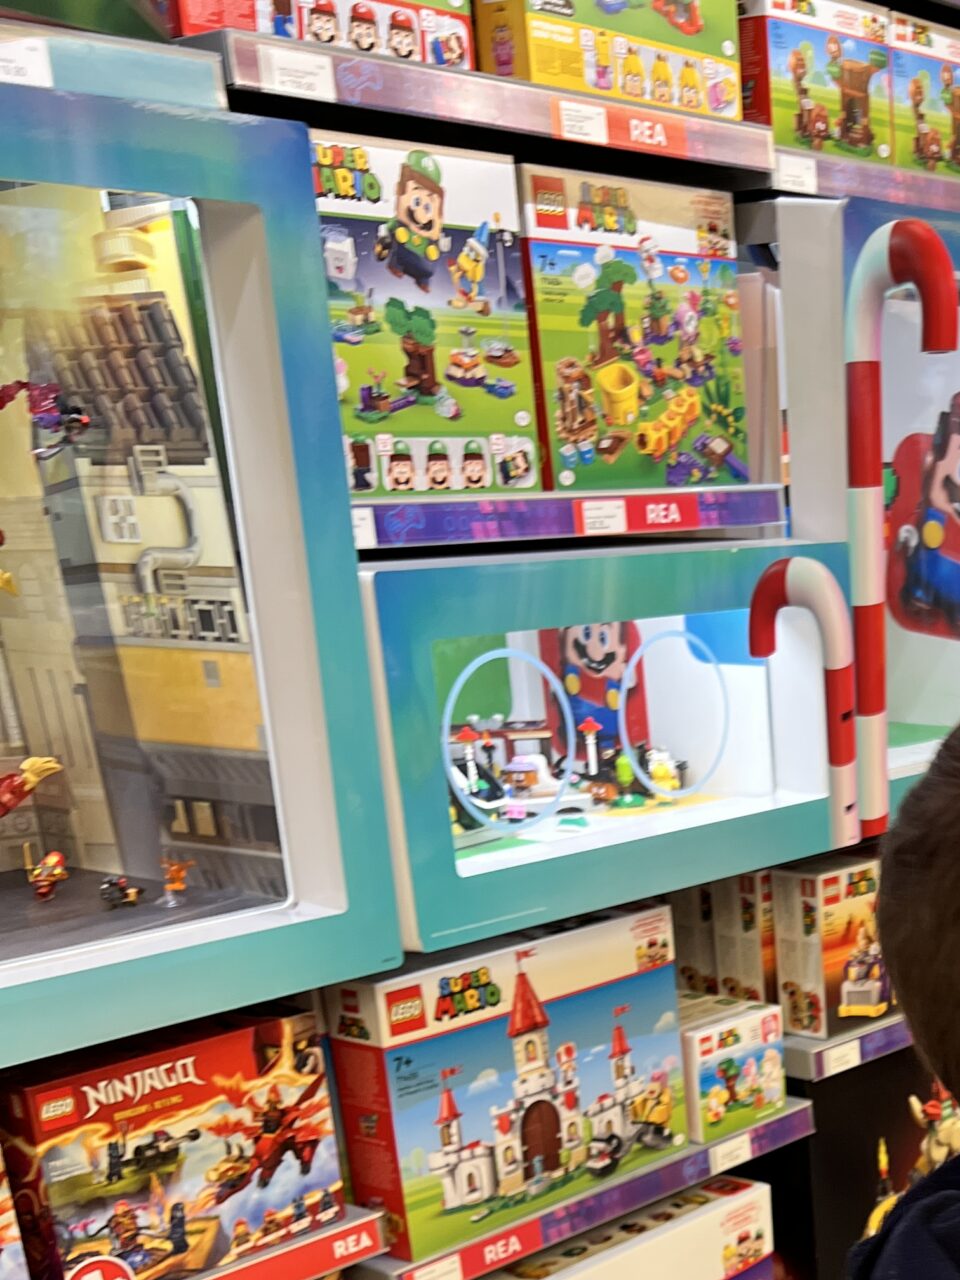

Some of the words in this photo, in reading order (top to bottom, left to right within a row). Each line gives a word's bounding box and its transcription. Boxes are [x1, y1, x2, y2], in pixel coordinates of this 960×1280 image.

[629, 118, 668, 147] REA
[646, 502, 682, 525] REA
[438, 966, 491, 997] SUPER
[390, 998, 424, 1024] LEGO
[434, 983, 501, 1021] MARIO
[80, 1056, 207, 1120] NINJAGO
[40, 1096, 75, 1122] LEGO
[332, 1230, 374, 1259] REA
[483, 1234, 522, 1265] REA
